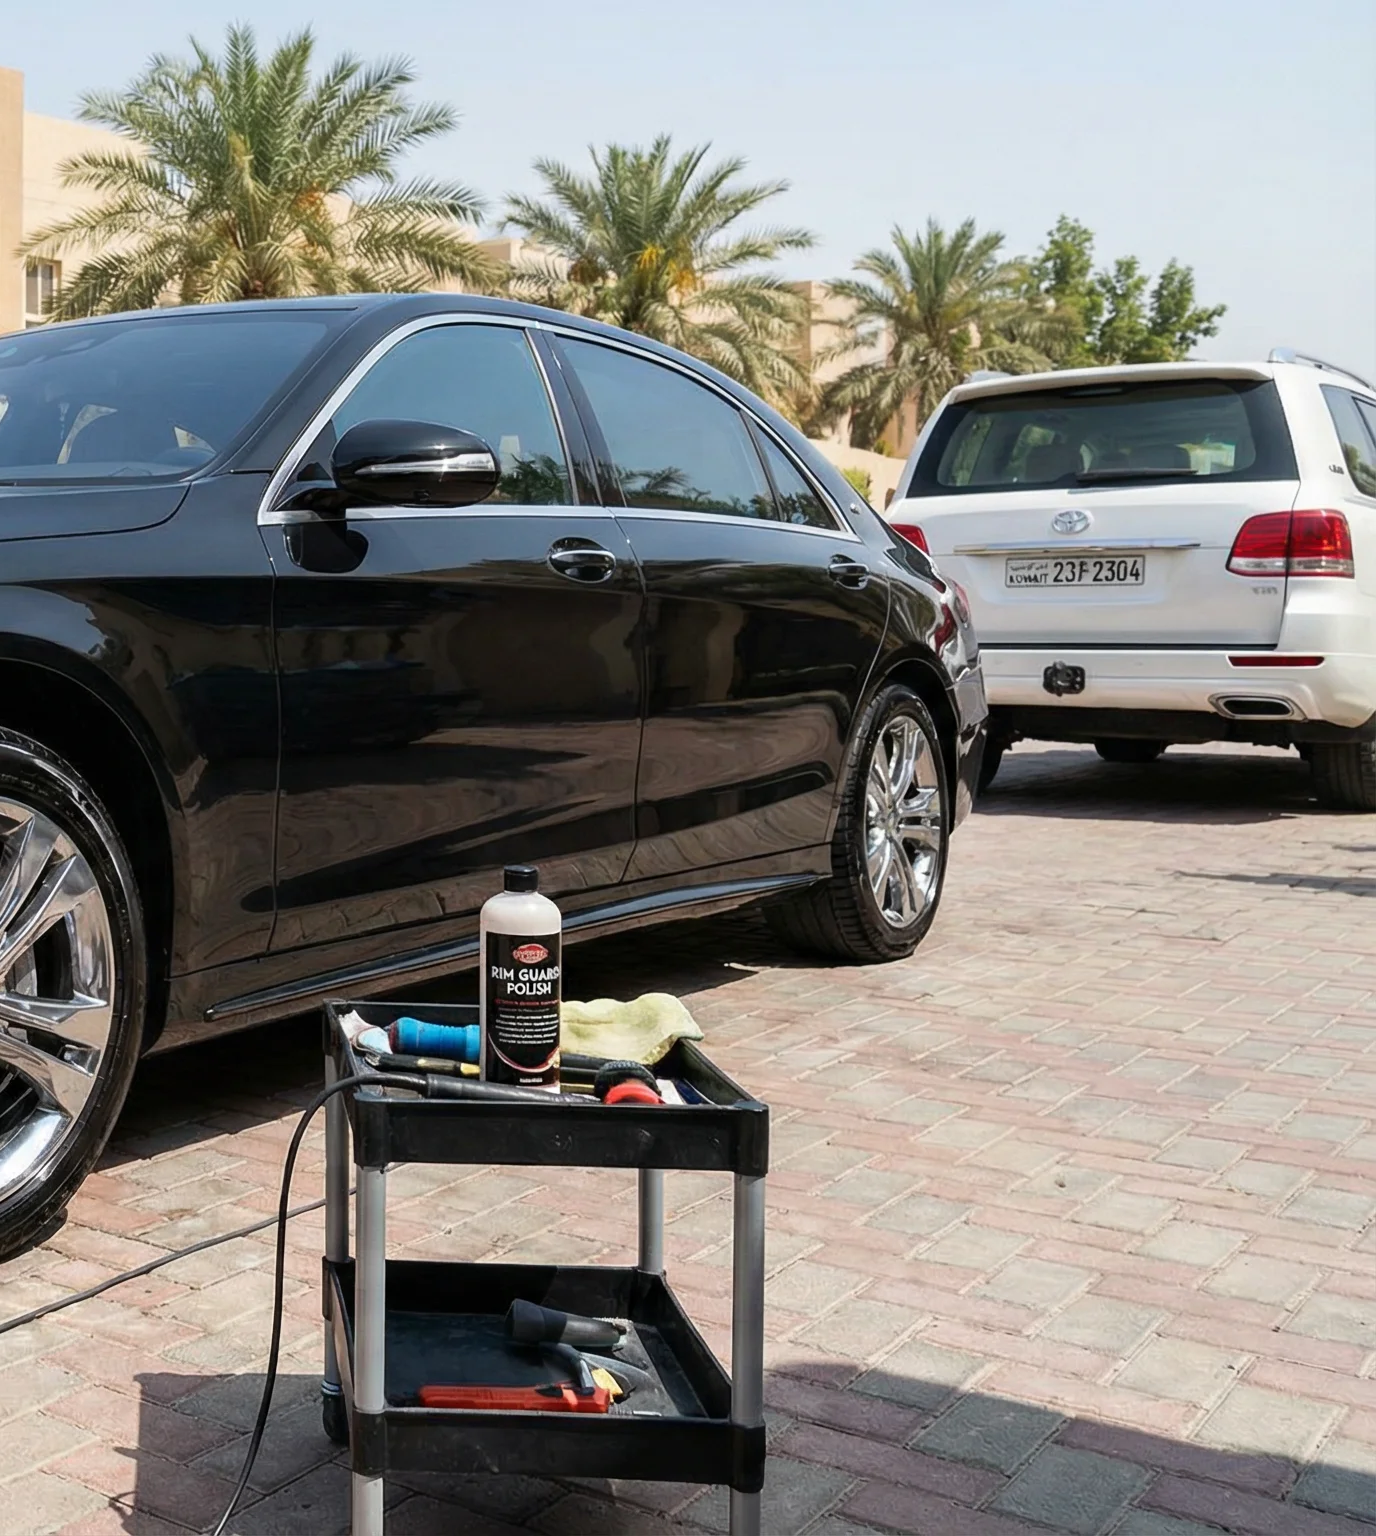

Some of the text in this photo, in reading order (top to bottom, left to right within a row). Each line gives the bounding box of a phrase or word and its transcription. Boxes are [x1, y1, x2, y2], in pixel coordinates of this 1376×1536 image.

[1092, 560, 1140, 582] 2304
[491, 965, 514, 981] RIM
[506, 982, 552, 996] POLISH
